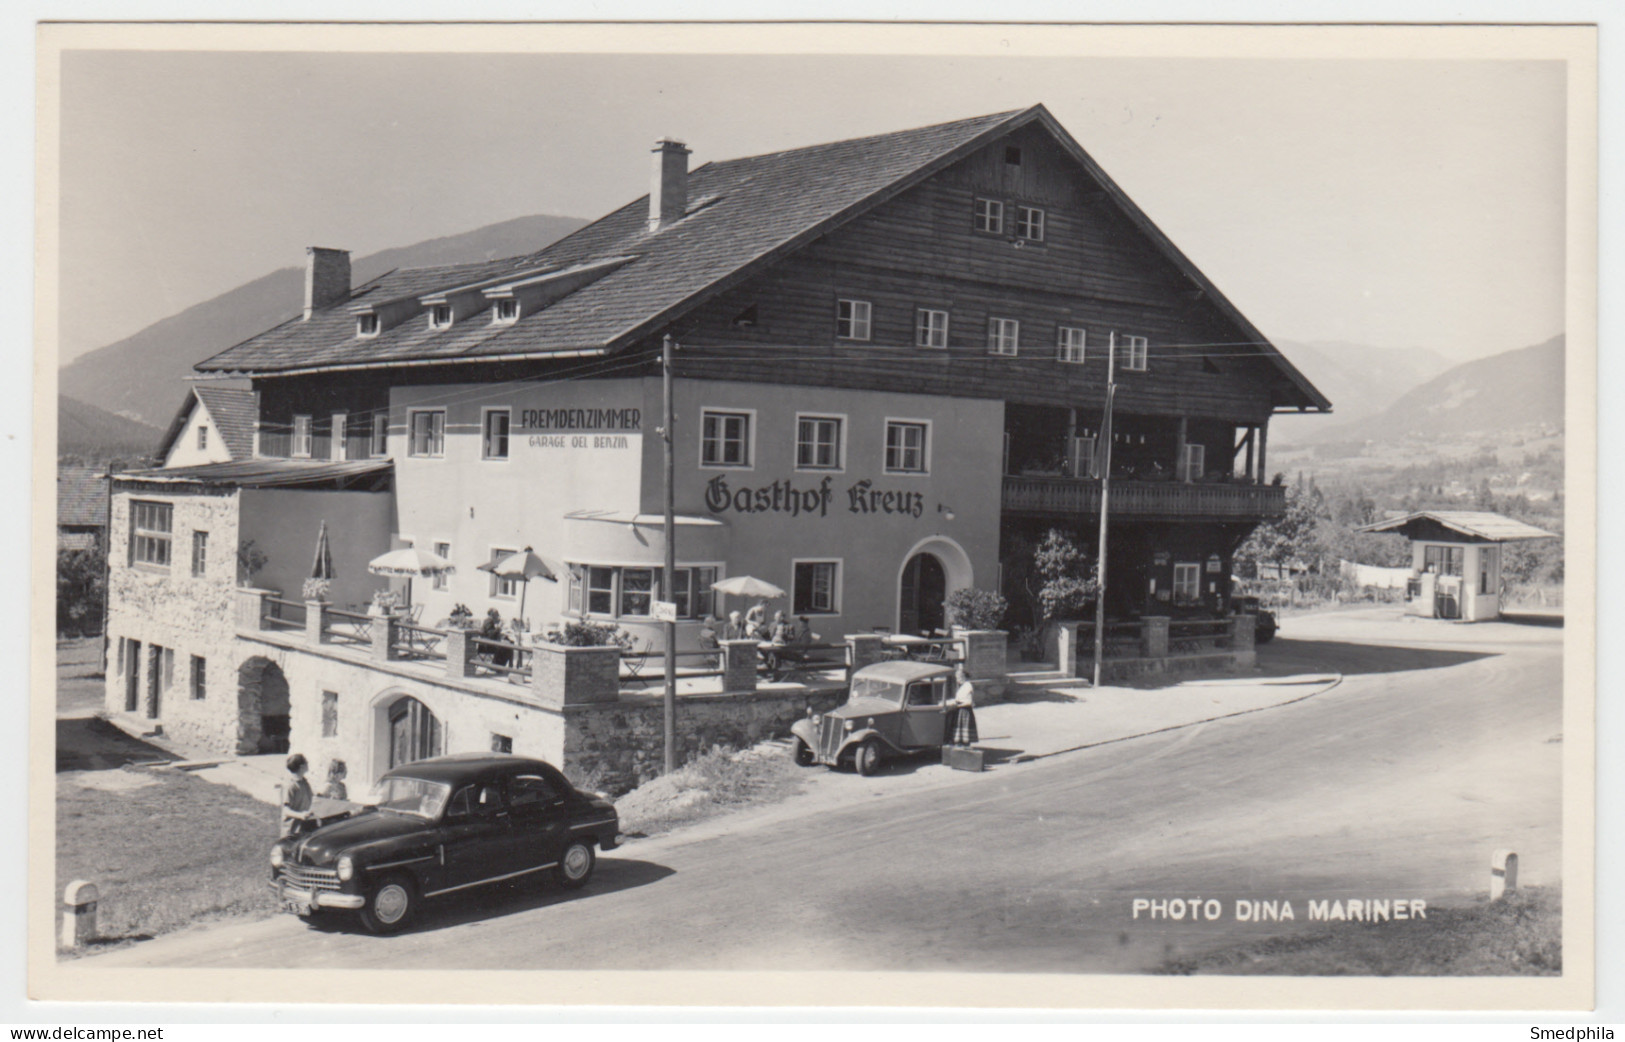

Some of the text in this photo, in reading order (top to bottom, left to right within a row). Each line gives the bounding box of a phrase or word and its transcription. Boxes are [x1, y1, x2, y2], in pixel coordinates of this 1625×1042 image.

[521, 408, 641, 430] FREMDENZIMMER
[528, 435, 629, 450] GARAGE OEL BENZIN
[704, 473, 924, 519] Gasthof Kreuz
